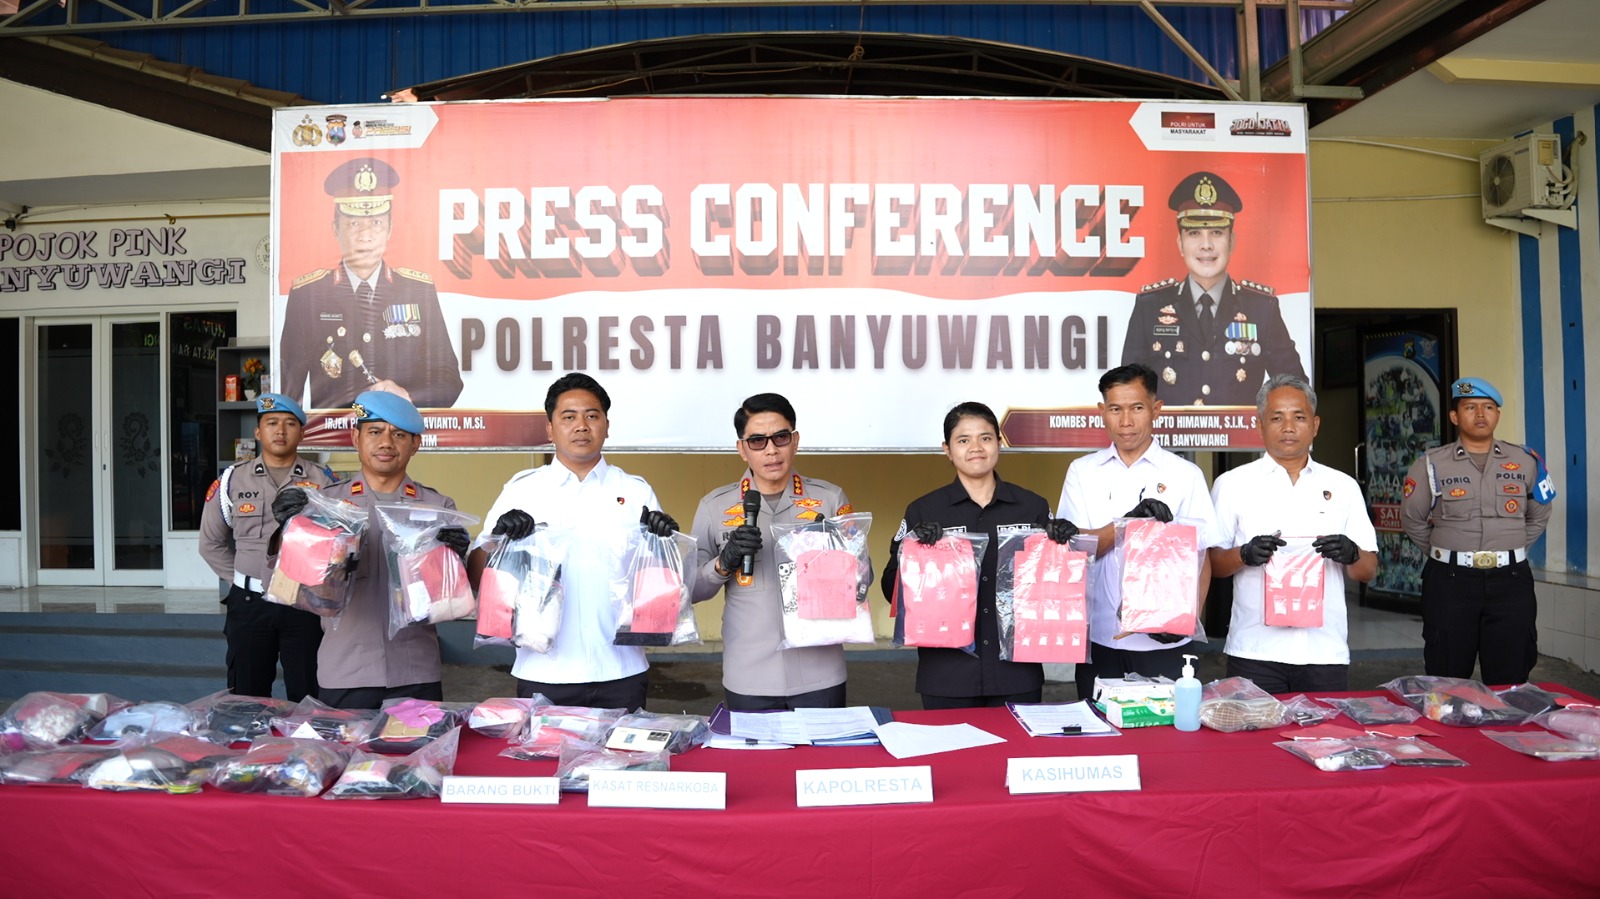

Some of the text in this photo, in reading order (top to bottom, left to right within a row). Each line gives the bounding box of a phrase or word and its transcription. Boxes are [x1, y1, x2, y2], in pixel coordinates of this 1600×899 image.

[438, 183, 1145, 260] PRESS CONFERENCE
[109, 227, 187, 257] PINK
[0, 258, 246, 293] NYUWANGI
[461, 315, 1108, 371] POLRESTA BANYUWANGI
[325, 417, 348, 429] IRJEN
[463, 416, 486, 429] M.Si.
[1050, 415, 1087, 428] KOMBES
[1089, 415, 1105, 428] POL
[1177, 416, 1222, 429] HIMAWAN,
[1224, 416, 1249, 429] S.I.K.,
[1172, 434, 1229, 446] BANYUWANGI
[1441, 476, 1471, 486] TORIQ
[1496, 472, 1526, 480] POLRI
[238, 491, 260, 499] ROY
[1022, 765, 1123, 781] KASIHUMAS
[446, 784, 555, 796] BARANG BUKTI
[593, 780, 719, 793] KASAT RESNARKOBA
[803, 778, 923, 794] KAPOLRESTA
